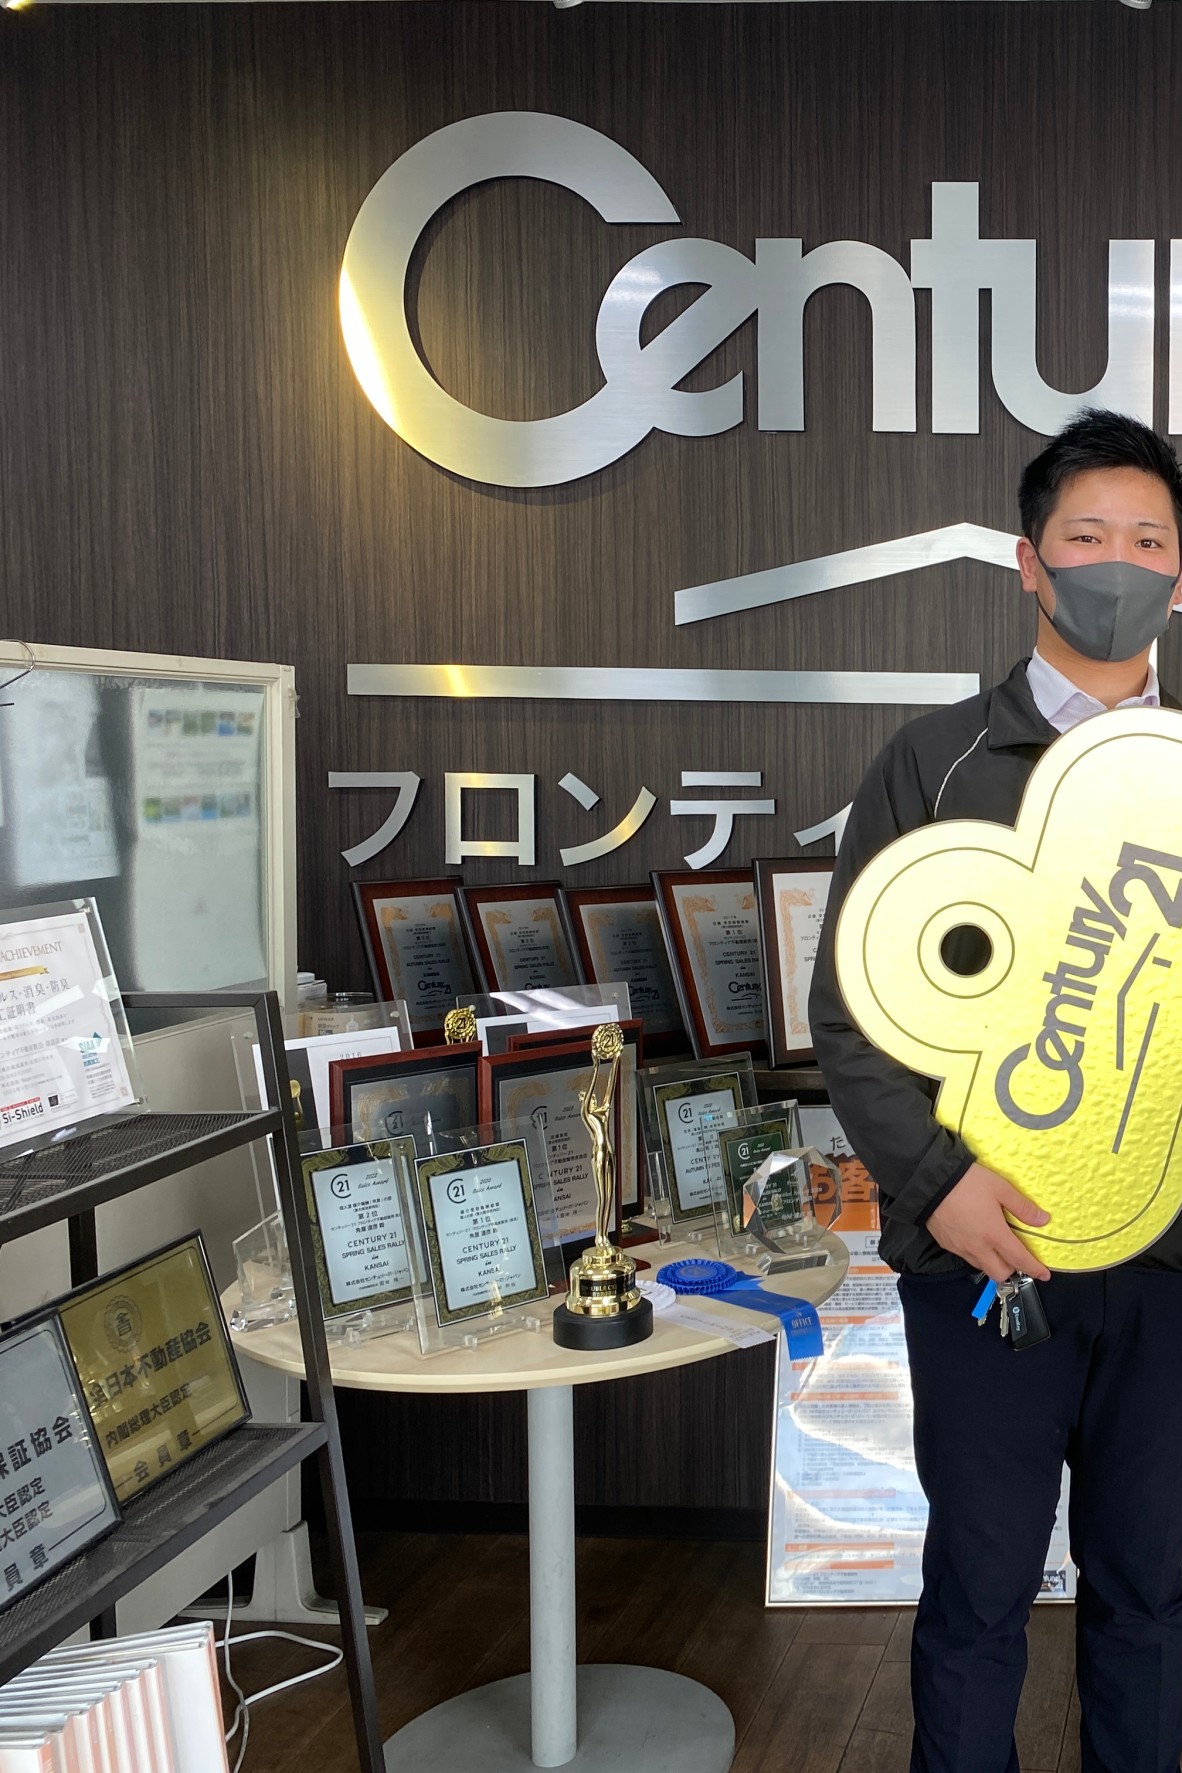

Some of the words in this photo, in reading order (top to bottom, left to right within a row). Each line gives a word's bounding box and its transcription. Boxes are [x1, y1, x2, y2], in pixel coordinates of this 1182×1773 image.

[994, 876, 1128, 1131] Century
[2, 1102, 44, 1125] Si-Shield
[553, 1193, 572, 1202] ANSAI
[347, 1233, 387, 1248] CENTURY
[389, 1231, 397, 1239] 21
[462, 1239, 500, 1254] CENTURY
[502, 1237, 509, 1245] 21
[341, 1249, 365, 1259] SPRING
[366, 1244, 387, 1255] SALES
[387, 1240, 406, 1249] RALLY
[456, 1255, 478, 1265] SPRING
[479, 1250, 499, 1259] SALES
[364, 1260, 389, 1271] KANSAI
[89, 1321, 213, 1404] 全日本不動産協会
[104, 1382, 194, 1450] 内閣総理大臣認定
